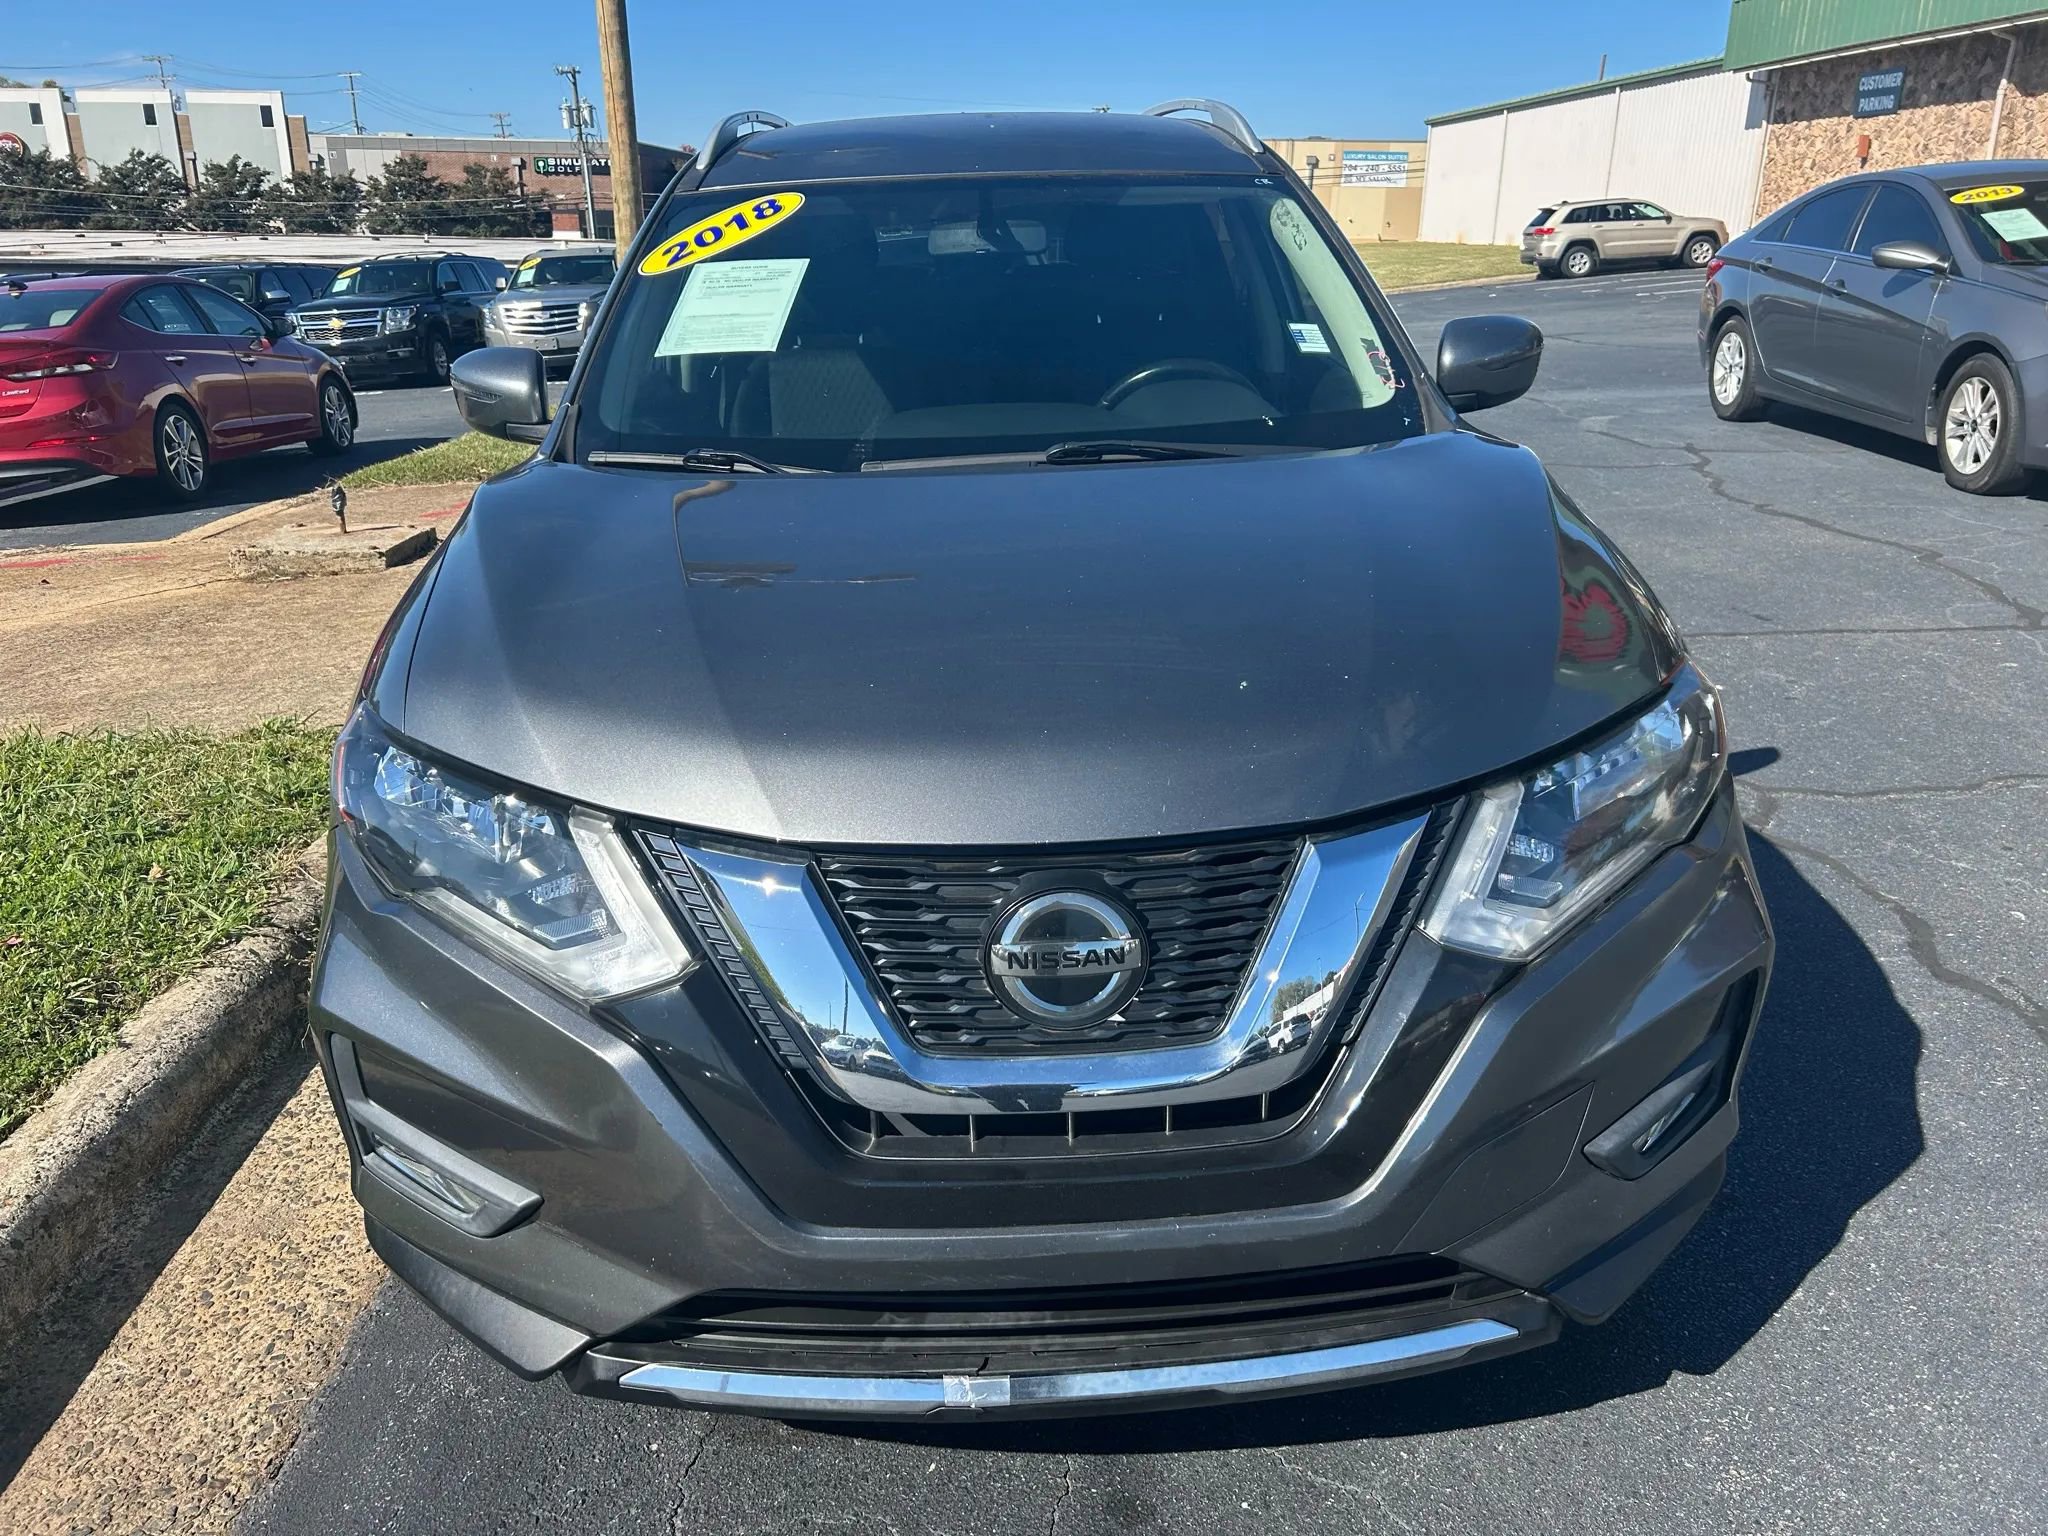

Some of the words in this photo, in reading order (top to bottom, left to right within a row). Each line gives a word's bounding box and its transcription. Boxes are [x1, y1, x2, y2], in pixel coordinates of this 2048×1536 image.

[1859, 72, 1903, 91] CUSTOMER
[1858, 95, 1894, 112] PARKING
[1961, 187, 2015, 202] 2013
[661, 198, 785, 268] 2018
[2, 388, 30, 397] Limited
[1007, 946, 1126, 970] NISSAN
